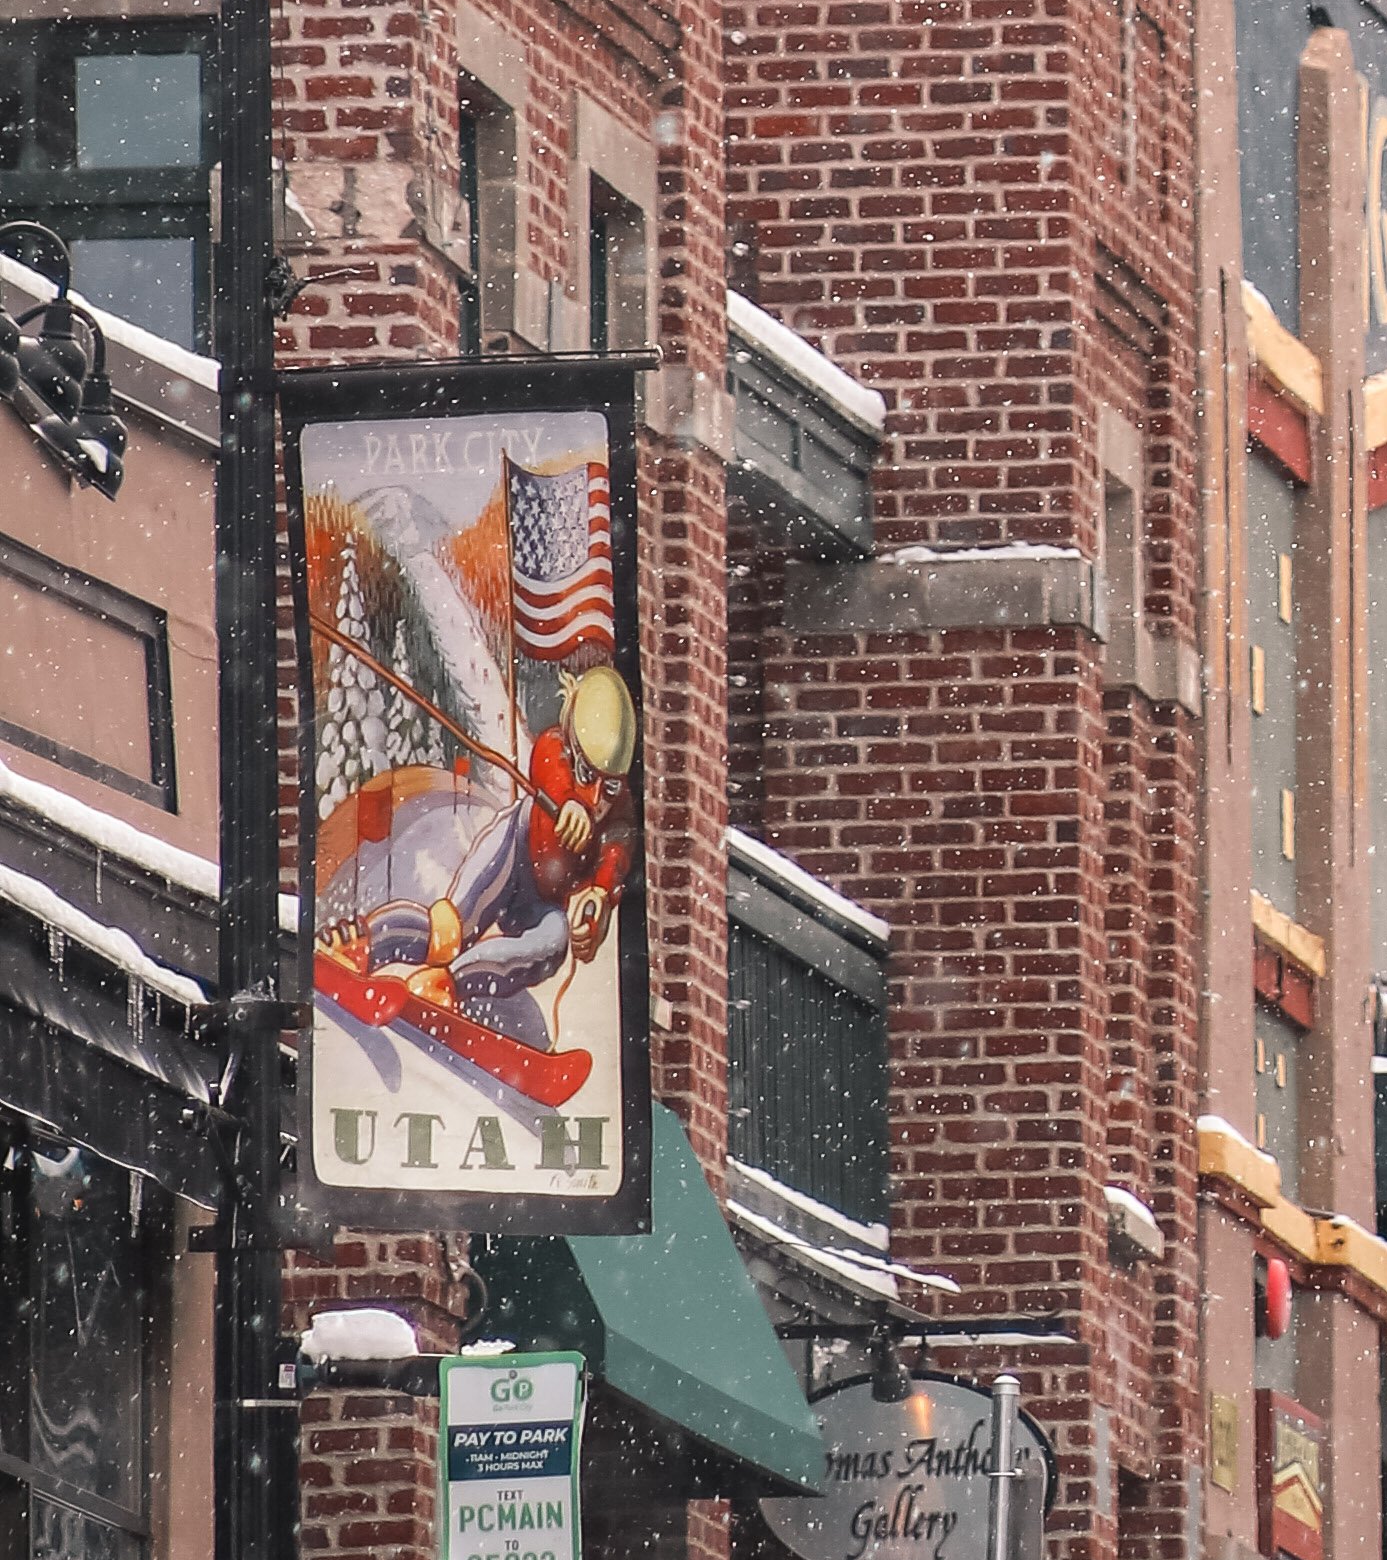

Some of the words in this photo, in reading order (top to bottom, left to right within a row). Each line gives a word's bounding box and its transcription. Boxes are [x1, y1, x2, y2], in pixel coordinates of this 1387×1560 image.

[364, 432, 454, 475] PARK
[464, 427, 545, 470] CITY
[328, 1107, 612, 1171] UTAH
[453, 1432, 492, 1448] PAY
[494, 1430, 517, 1446] TO
[519, 1427, 568, 1444] PARK
[500, 1450, 549, 1461] MIDNIGHT
[477, 1463, 484, 1473] 3
[485, 1462, 519, 1472] HOURS
[521, 1460, 544, 1470] MAX
[497, 1489, 524, 1501] TEXT
[459, 1501, 564, 1532] PCMAIN
[504, 1540, 519, 1551] TO
